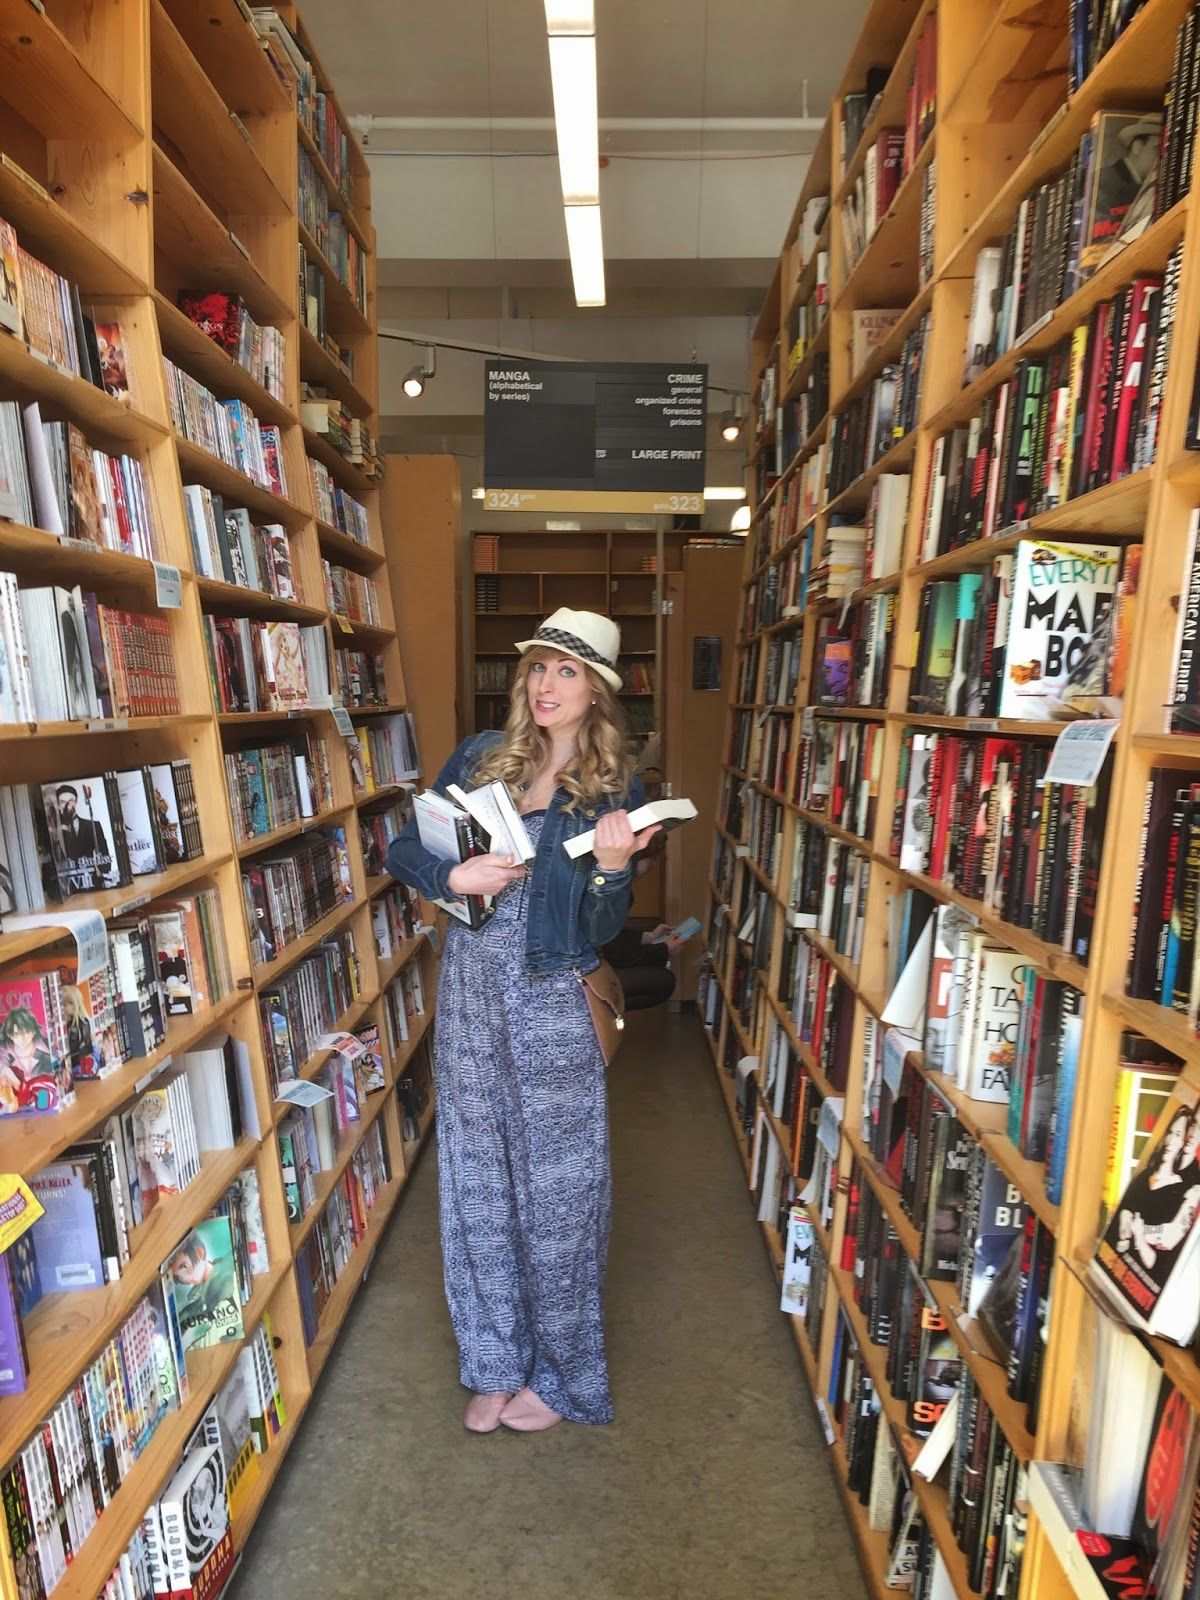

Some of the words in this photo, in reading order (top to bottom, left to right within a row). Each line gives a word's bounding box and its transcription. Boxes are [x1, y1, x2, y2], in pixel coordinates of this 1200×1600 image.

[1159, 257, 1176, 328] MASTER
[1150, 333, 1168, 407] THIEVES
[489, 371, 530, 381] MANGA
[667, 374, 703, 384] CRIME
[489, 381, 543, 391] (alphabetical
[671, 386, 703, 395] general
[489, 392, 500, 401] by
[501, 392, 530, 402] series)
[635, 397, 677, 406] organized
[678, 397, 702, 405] crime
[663, 407, 702, 415] forensics
[670, 418, 702, 427] prisons
[632, 450, 669, 459] LARGE
[671, 450, 702, 459] PRINT
[489, 493, 520, 508] 324
[669, 496, 700, 511] 323
[1094, 550, 1108, 559] THE
[1182, 561, 1200, 641] AMERICAN
[1176, 649, 1193, 703] FURIES
[144, 1517, 162, 1584] BUDDHA
[166, 1513, 185, 1580] BUDDHA
